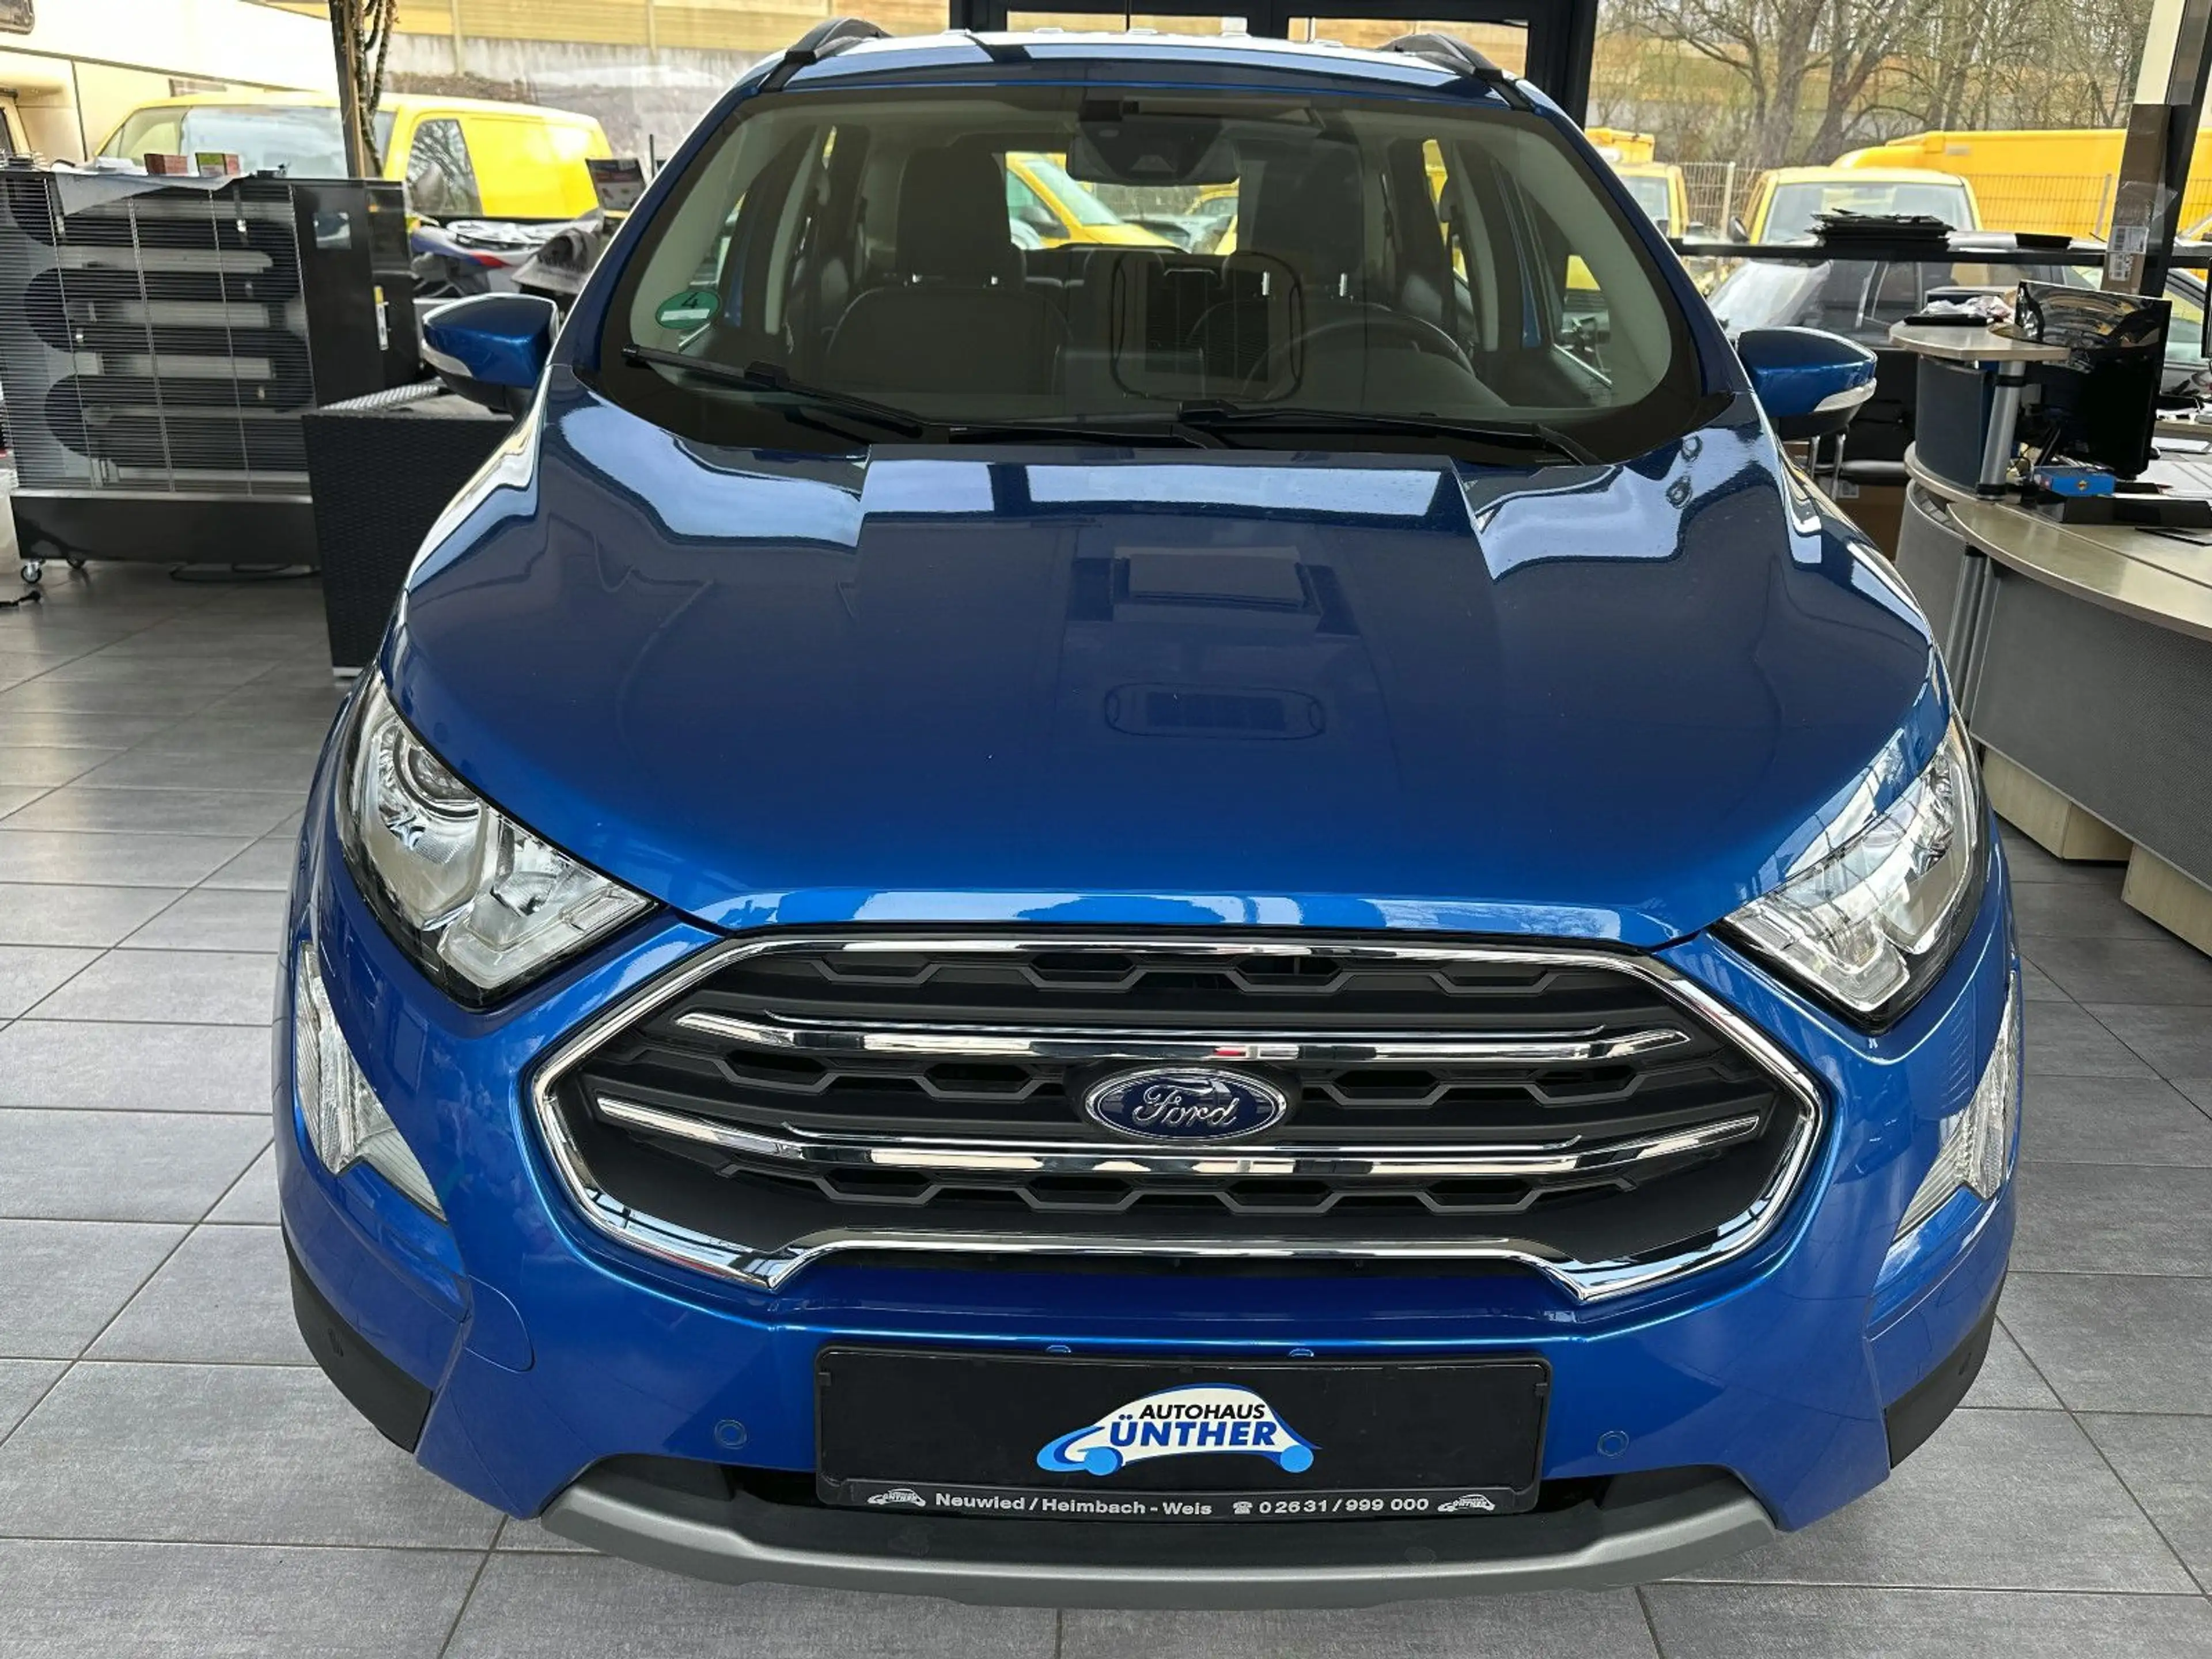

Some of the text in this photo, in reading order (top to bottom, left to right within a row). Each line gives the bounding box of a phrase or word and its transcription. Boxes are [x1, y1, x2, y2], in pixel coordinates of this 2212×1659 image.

[681, 292, 699, 309] 4
[1132, 1081, 1240, 1126] Ford
[1139, 1404, 1266, 1419] AUTOHAUS
[1391, 1498, 1429, 1512] 000
